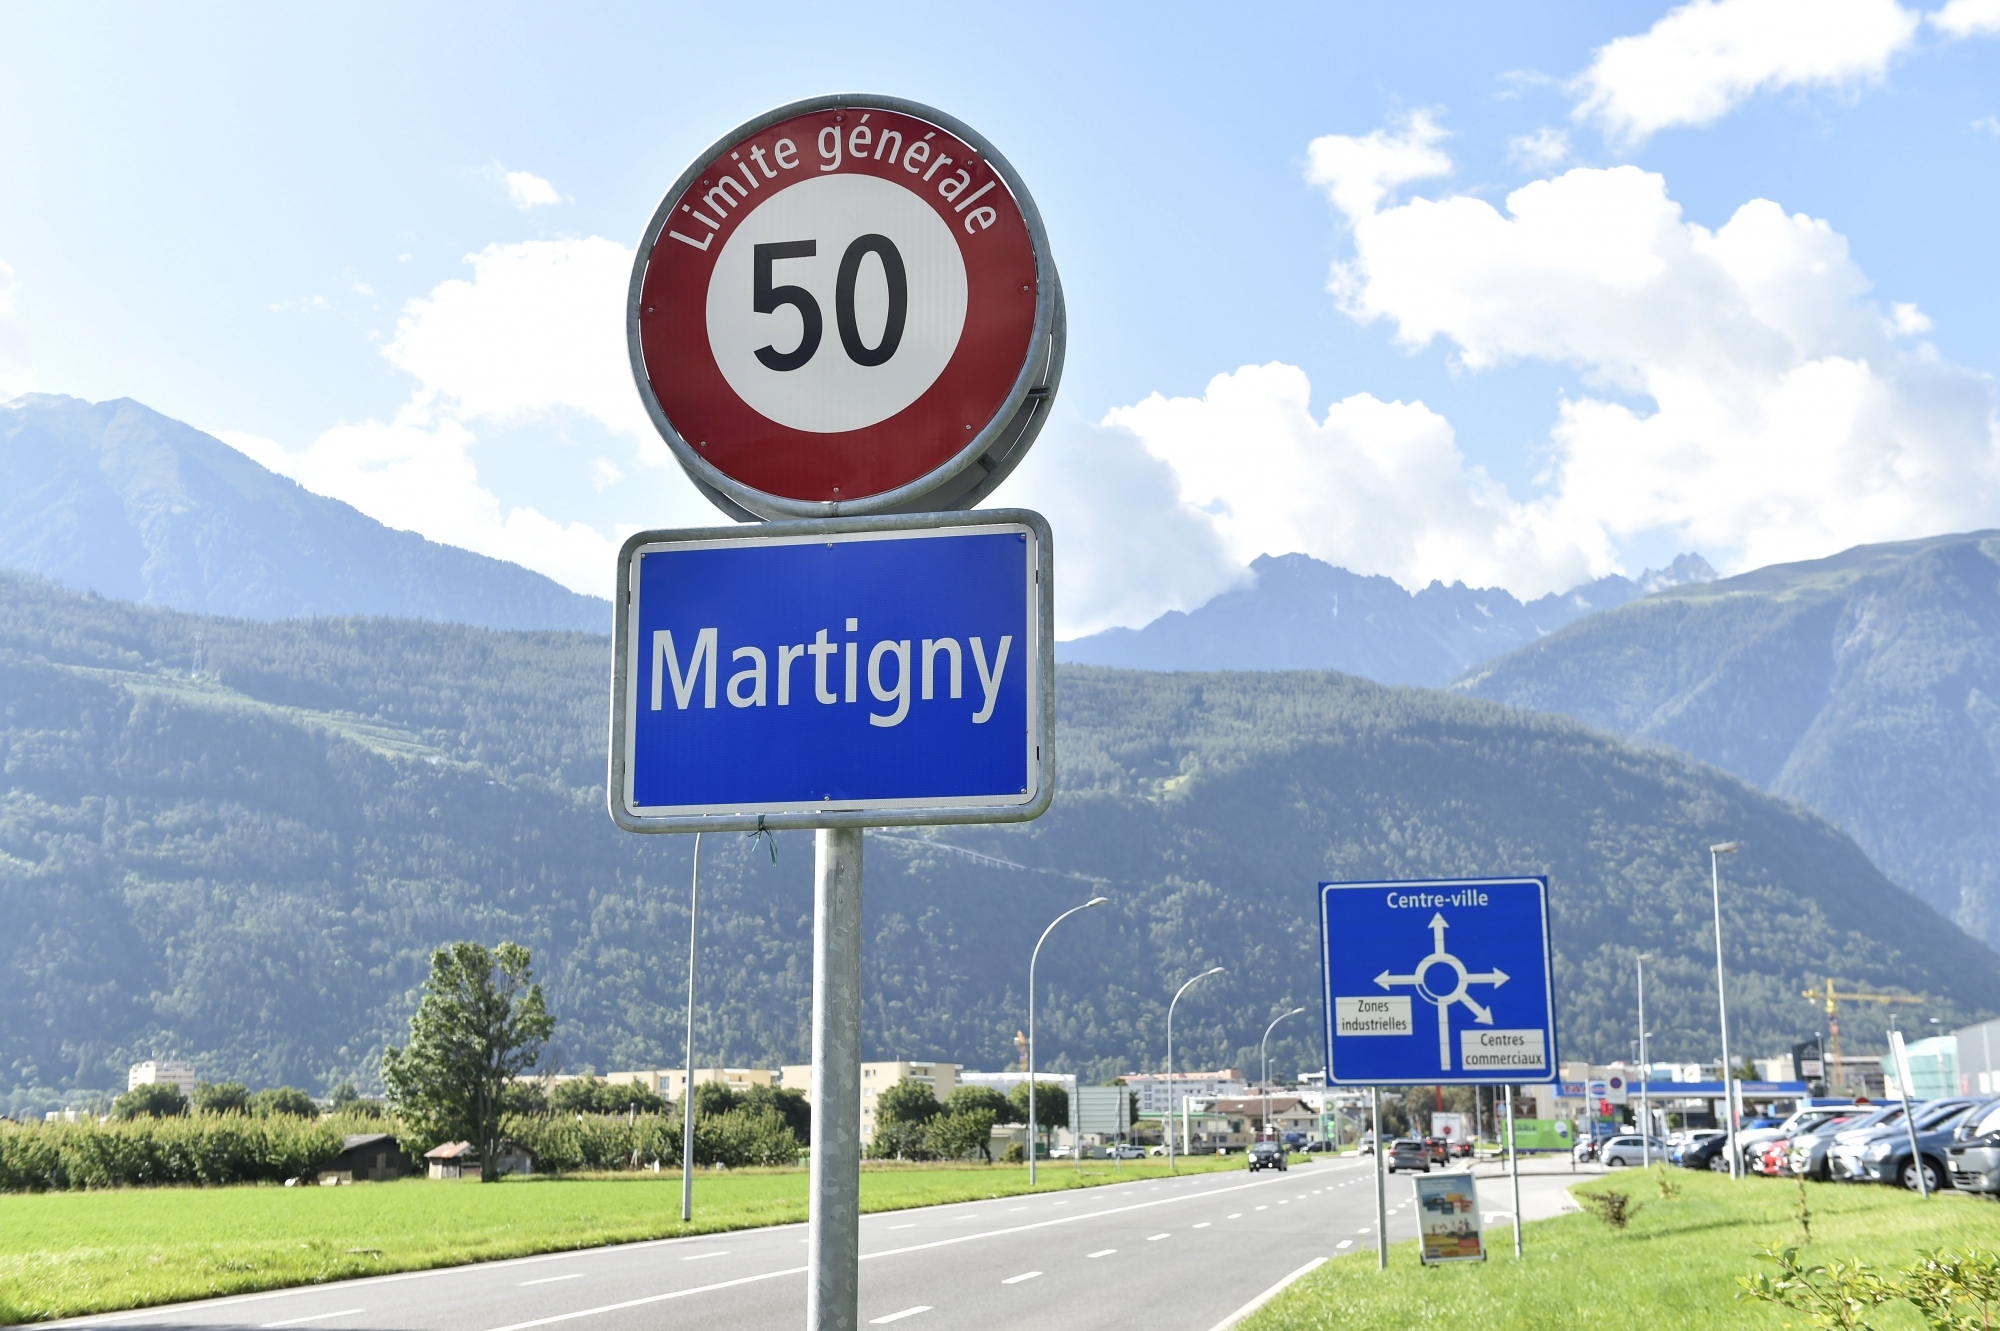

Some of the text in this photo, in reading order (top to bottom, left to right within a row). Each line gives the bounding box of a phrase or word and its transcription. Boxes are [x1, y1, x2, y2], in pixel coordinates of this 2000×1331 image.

[669, 113, 998, 252] Limite générale
[753, 233, 908, 372] 50
[650, 617, 1013, 728] Martigny
[1386, 889, 1489, 909] Centre-ville
[1358, 999, 1389, 1013] Zones
[1341, 1017, 1407, 1031] industrielles
[1480, 1033, 1525, 1047] Centres
[1465, 1053, 1542, 1065] commerciaux
